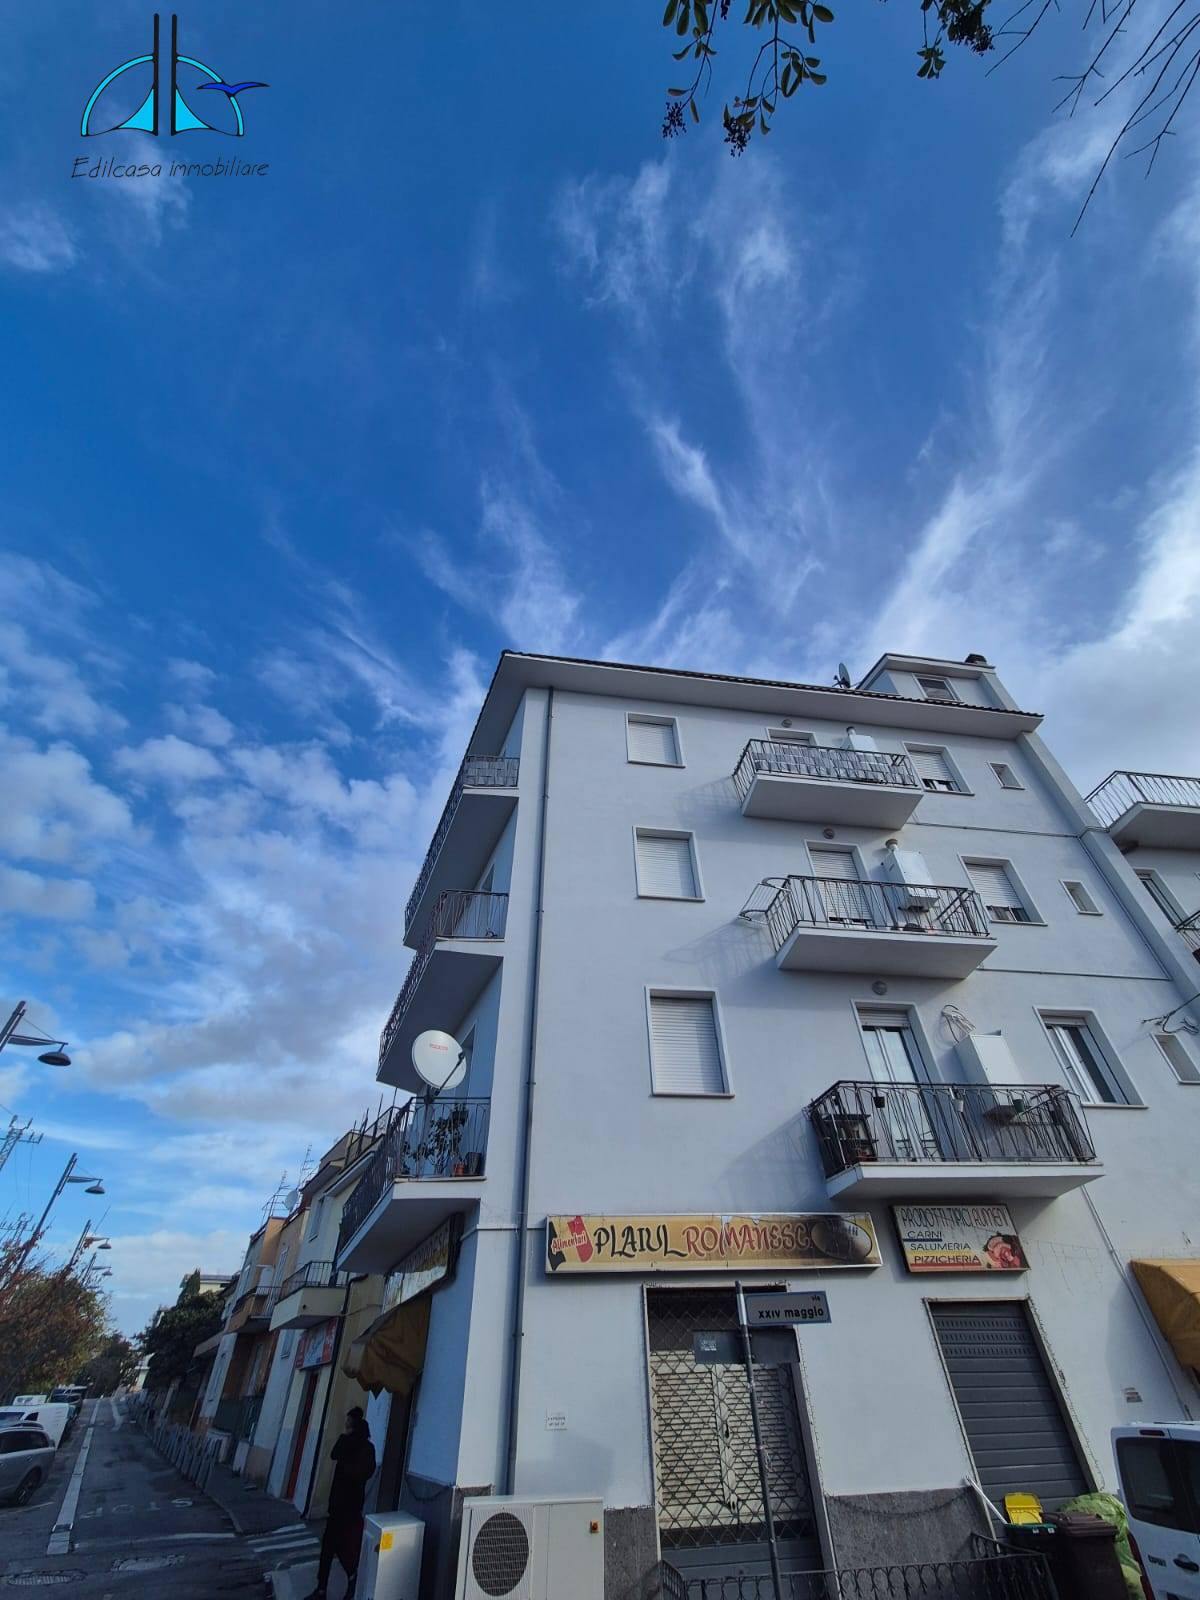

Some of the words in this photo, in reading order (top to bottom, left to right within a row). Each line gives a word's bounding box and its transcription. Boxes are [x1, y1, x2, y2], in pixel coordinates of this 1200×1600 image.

[594, 1224, 688, 1258] PLAIUL
[682, 1222, 811, 1257] ROMANESC
[907, 1230, 942, 1239] CARNI
[551, 1231, 588, 1253] Alimentari
[910, 1242, 972, 1252] SALUMERIA
[914, 1254, 981, 1265] PIZZICHERIA
[784, 1306, 824, 1319] maggio
